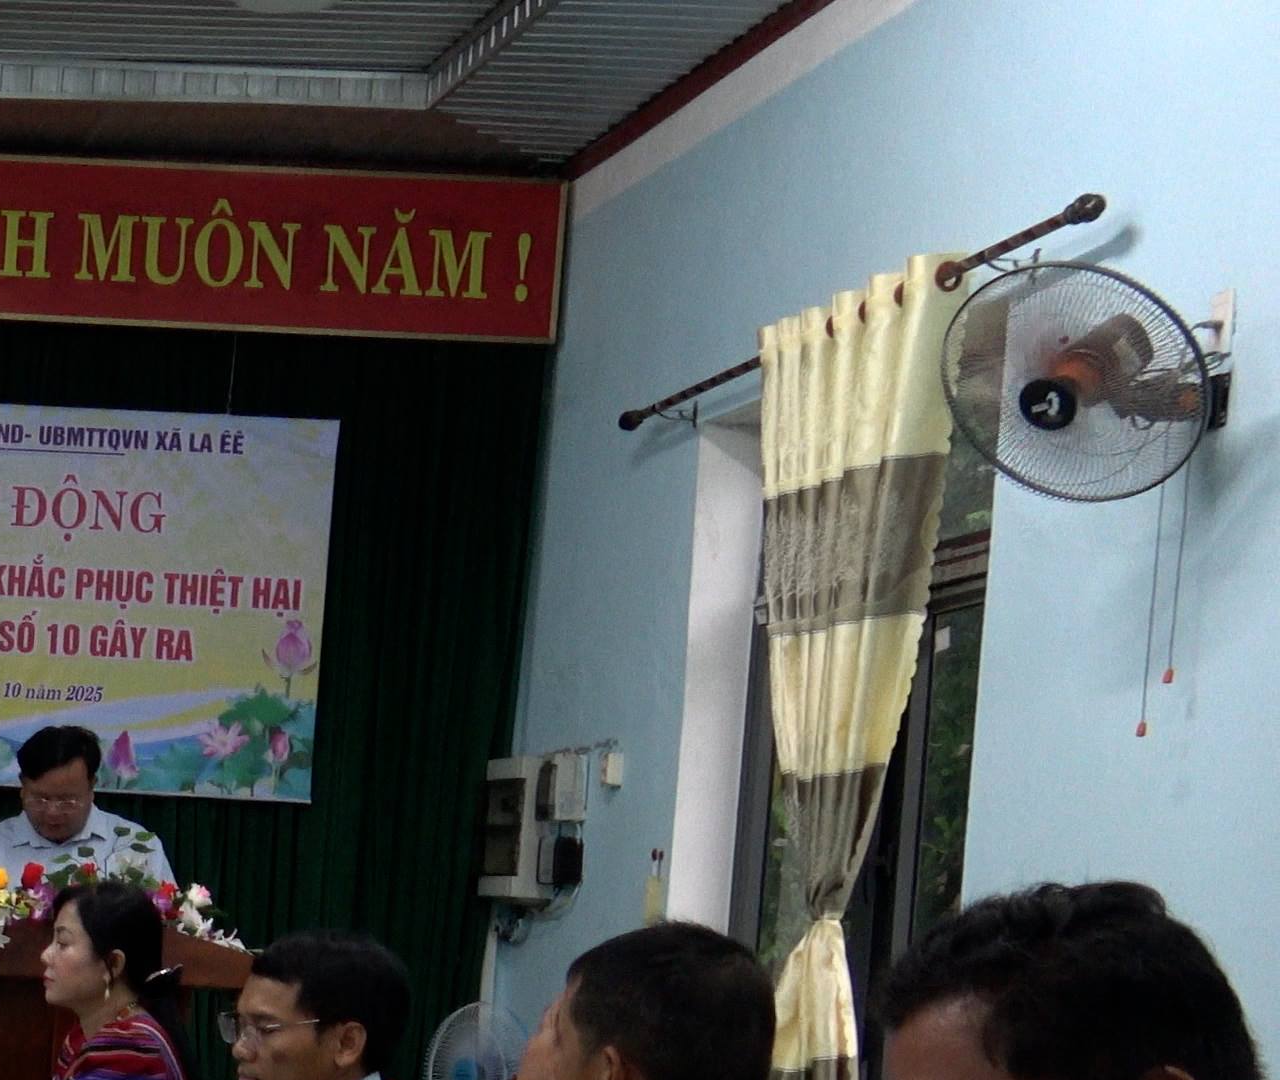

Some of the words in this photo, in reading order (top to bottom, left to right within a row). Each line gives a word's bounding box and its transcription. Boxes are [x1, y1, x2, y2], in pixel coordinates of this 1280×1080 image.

[74, 197, 303, 291] MUÔN
[319, 206, 493, 301] NĂM
[39, 425, 149, 450] UBMTTQVN
[155, 427, 182, 452] XÃ
[189, 432, 213, 453] LA
[10, 474, 167, 542] ĐỘNG
[75, 567, 154, 610] PHỤC
[164, 568, 244, 615] THIỆT
[251, 576, 302, 618] HẠI
[47, 622, 81, 656] 10
[89, 618, 147, 659] GÂY
[155, 627, 193, 662] RA
[3, 682, 22, 698] 10
[25, 685, 62, 701] năm
[65, 684, 104, 703] 2025
